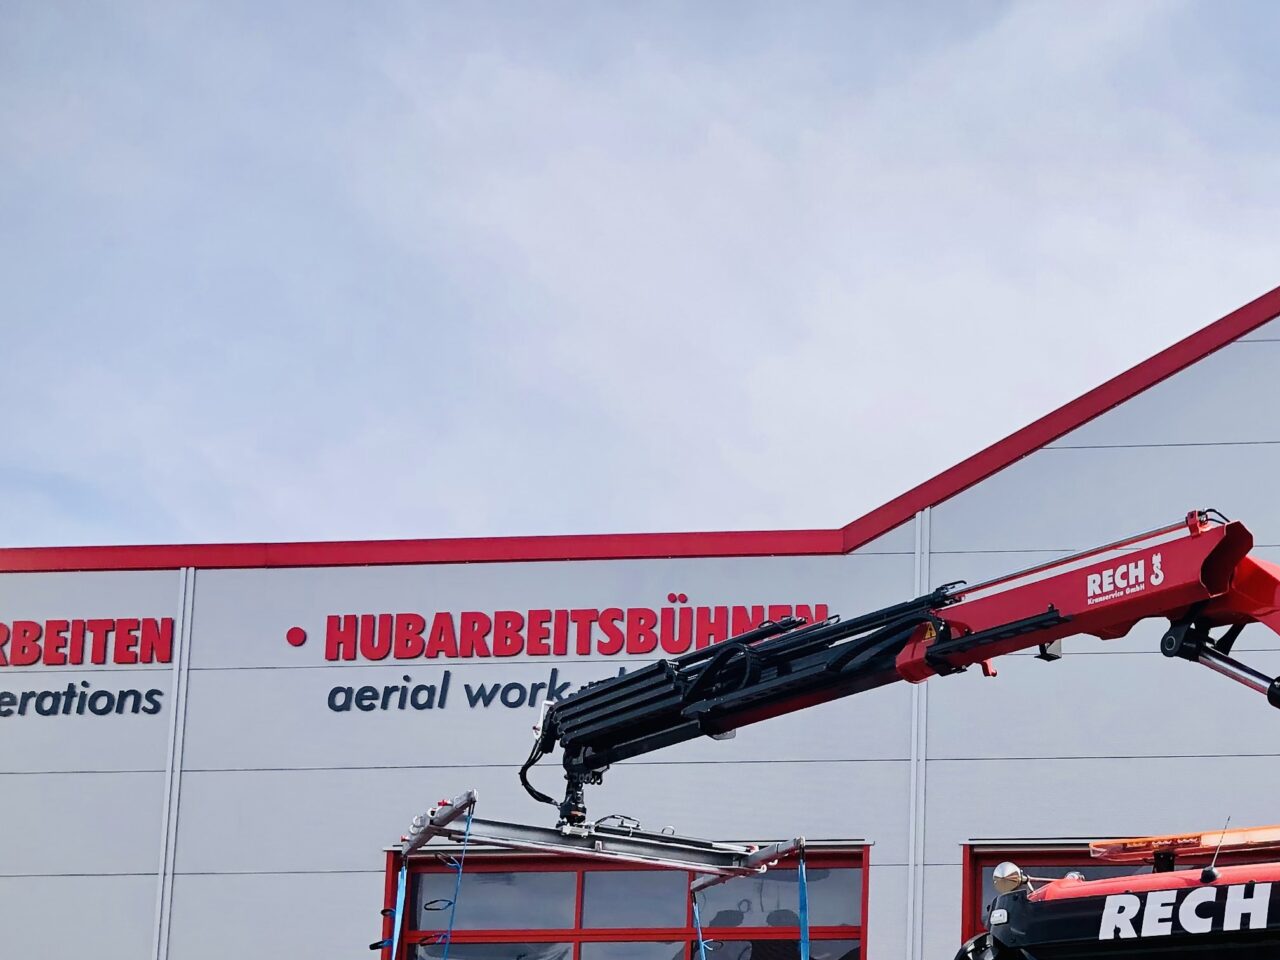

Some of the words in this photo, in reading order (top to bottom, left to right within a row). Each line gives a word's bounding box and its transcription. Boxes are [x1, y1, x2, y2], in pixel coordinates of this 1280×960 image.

[1087, 559, 1145, 597] RECH
[0, 680, 164, 717] erations
[327, 670, 451, 712] aerial
[1099, 883, 1272, 940] RECH
